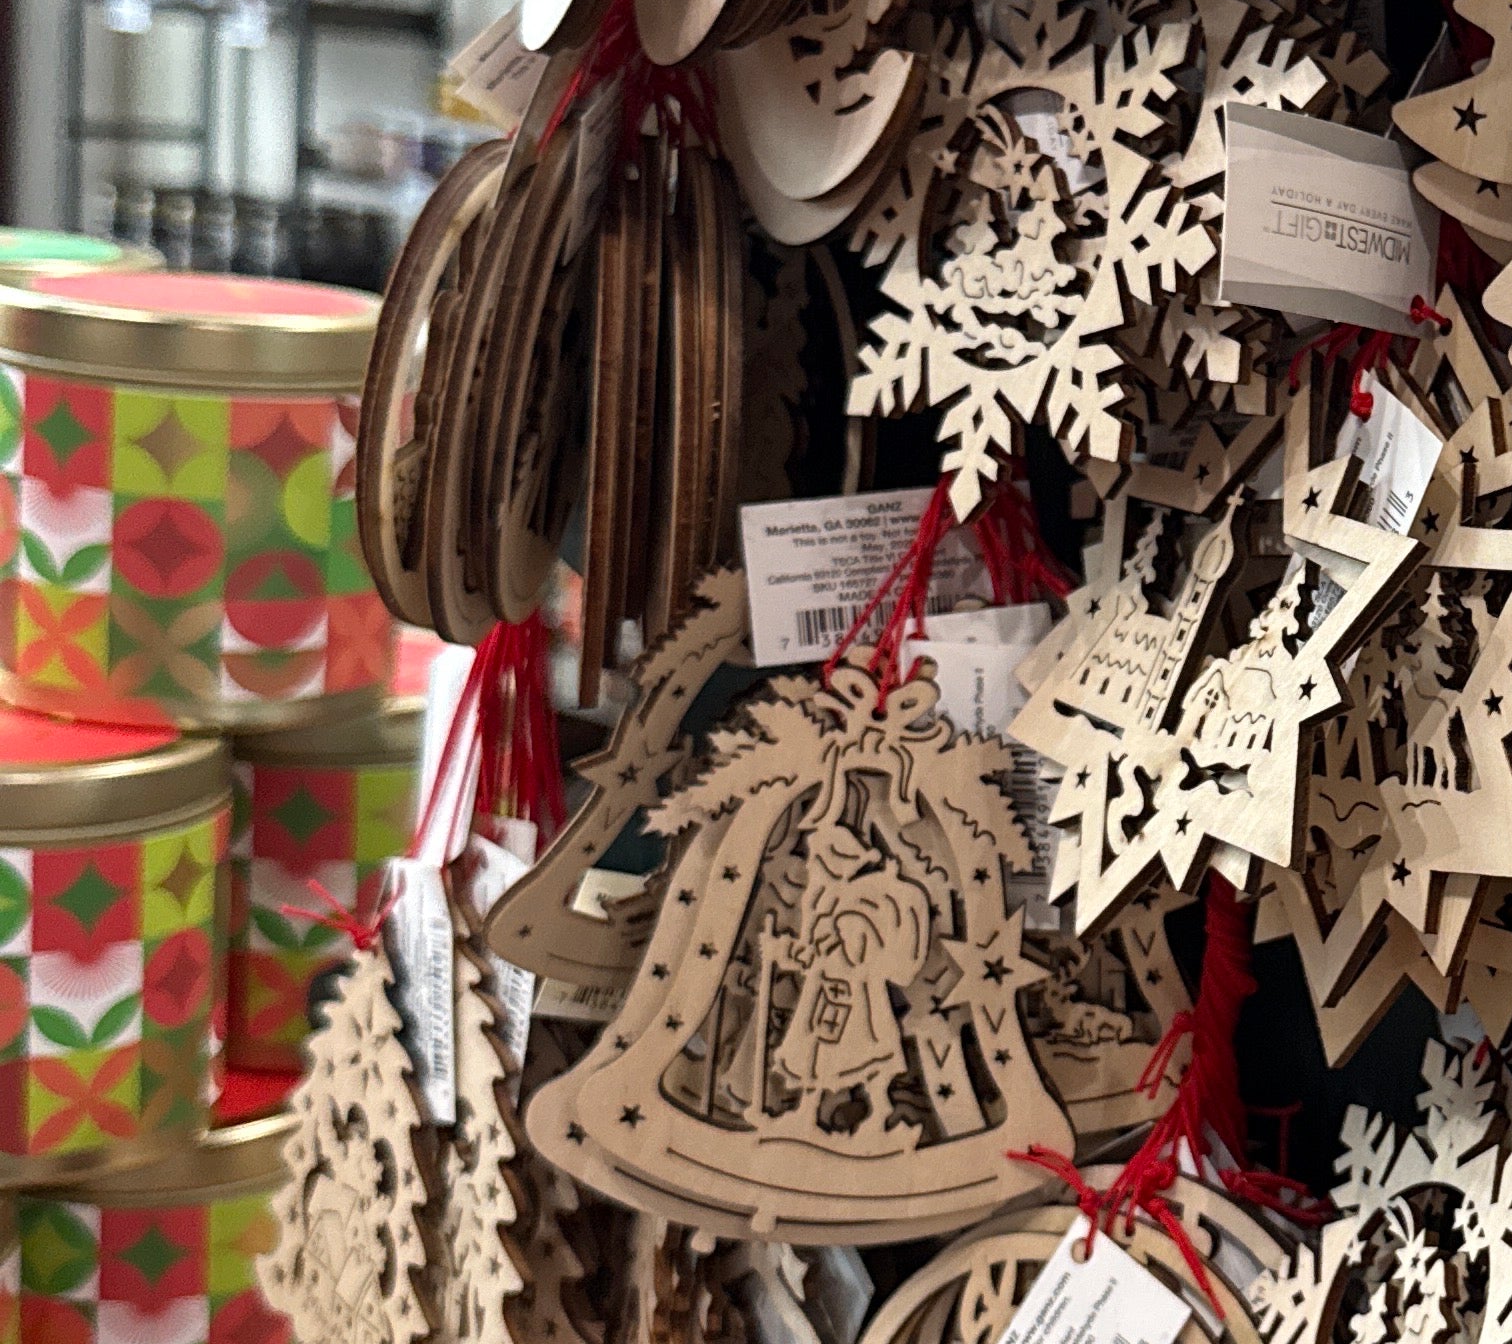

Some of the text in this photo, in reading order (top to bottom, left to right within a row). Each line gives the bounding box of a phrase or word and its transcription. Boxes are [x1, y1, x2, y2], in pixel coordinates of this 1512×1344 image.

[1271, 185, 1321, 205] HOLIDAY
[1337, 200, 1356, 213] DAY
[1272, 209, 1411, 265] MIDWEST GIFT
[1405, 490, 1414, 503] 3
[867, 500, 902, 514] GANZ
[765, 521, 821, 538] Marietta,
[823, 519, 841, 531] GA
